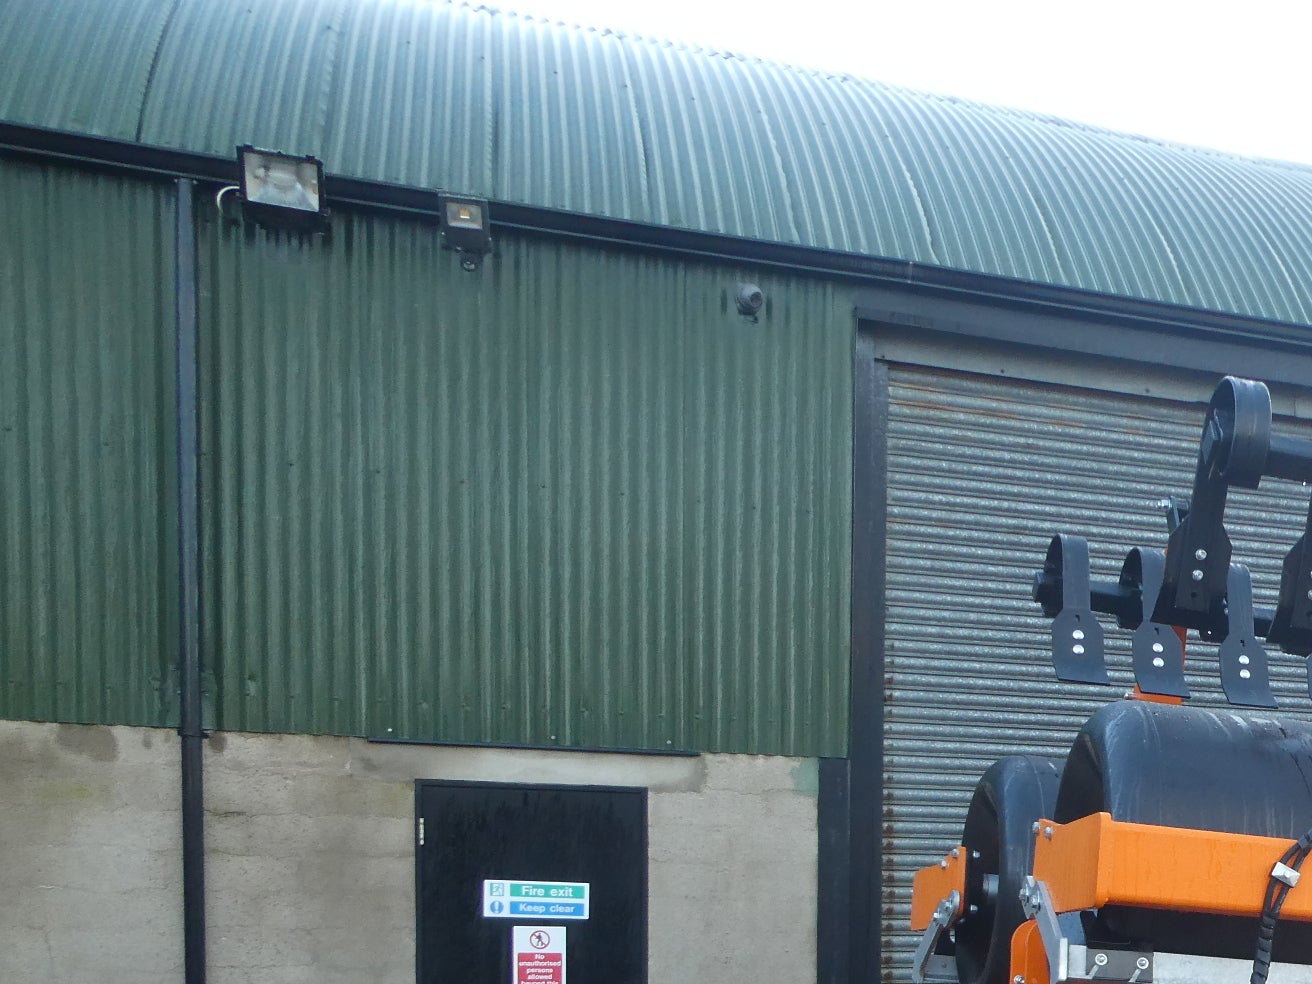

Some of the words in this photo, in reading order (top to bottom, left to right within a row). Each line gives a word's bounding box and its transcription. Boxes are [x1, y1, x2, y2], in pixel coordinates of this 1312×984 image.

[521, 885, 545, 897] Fire
[550, 887, 573, 897] exit
[519, 903, 546, 914] Keep
[549, 904, 575, 913] clear
